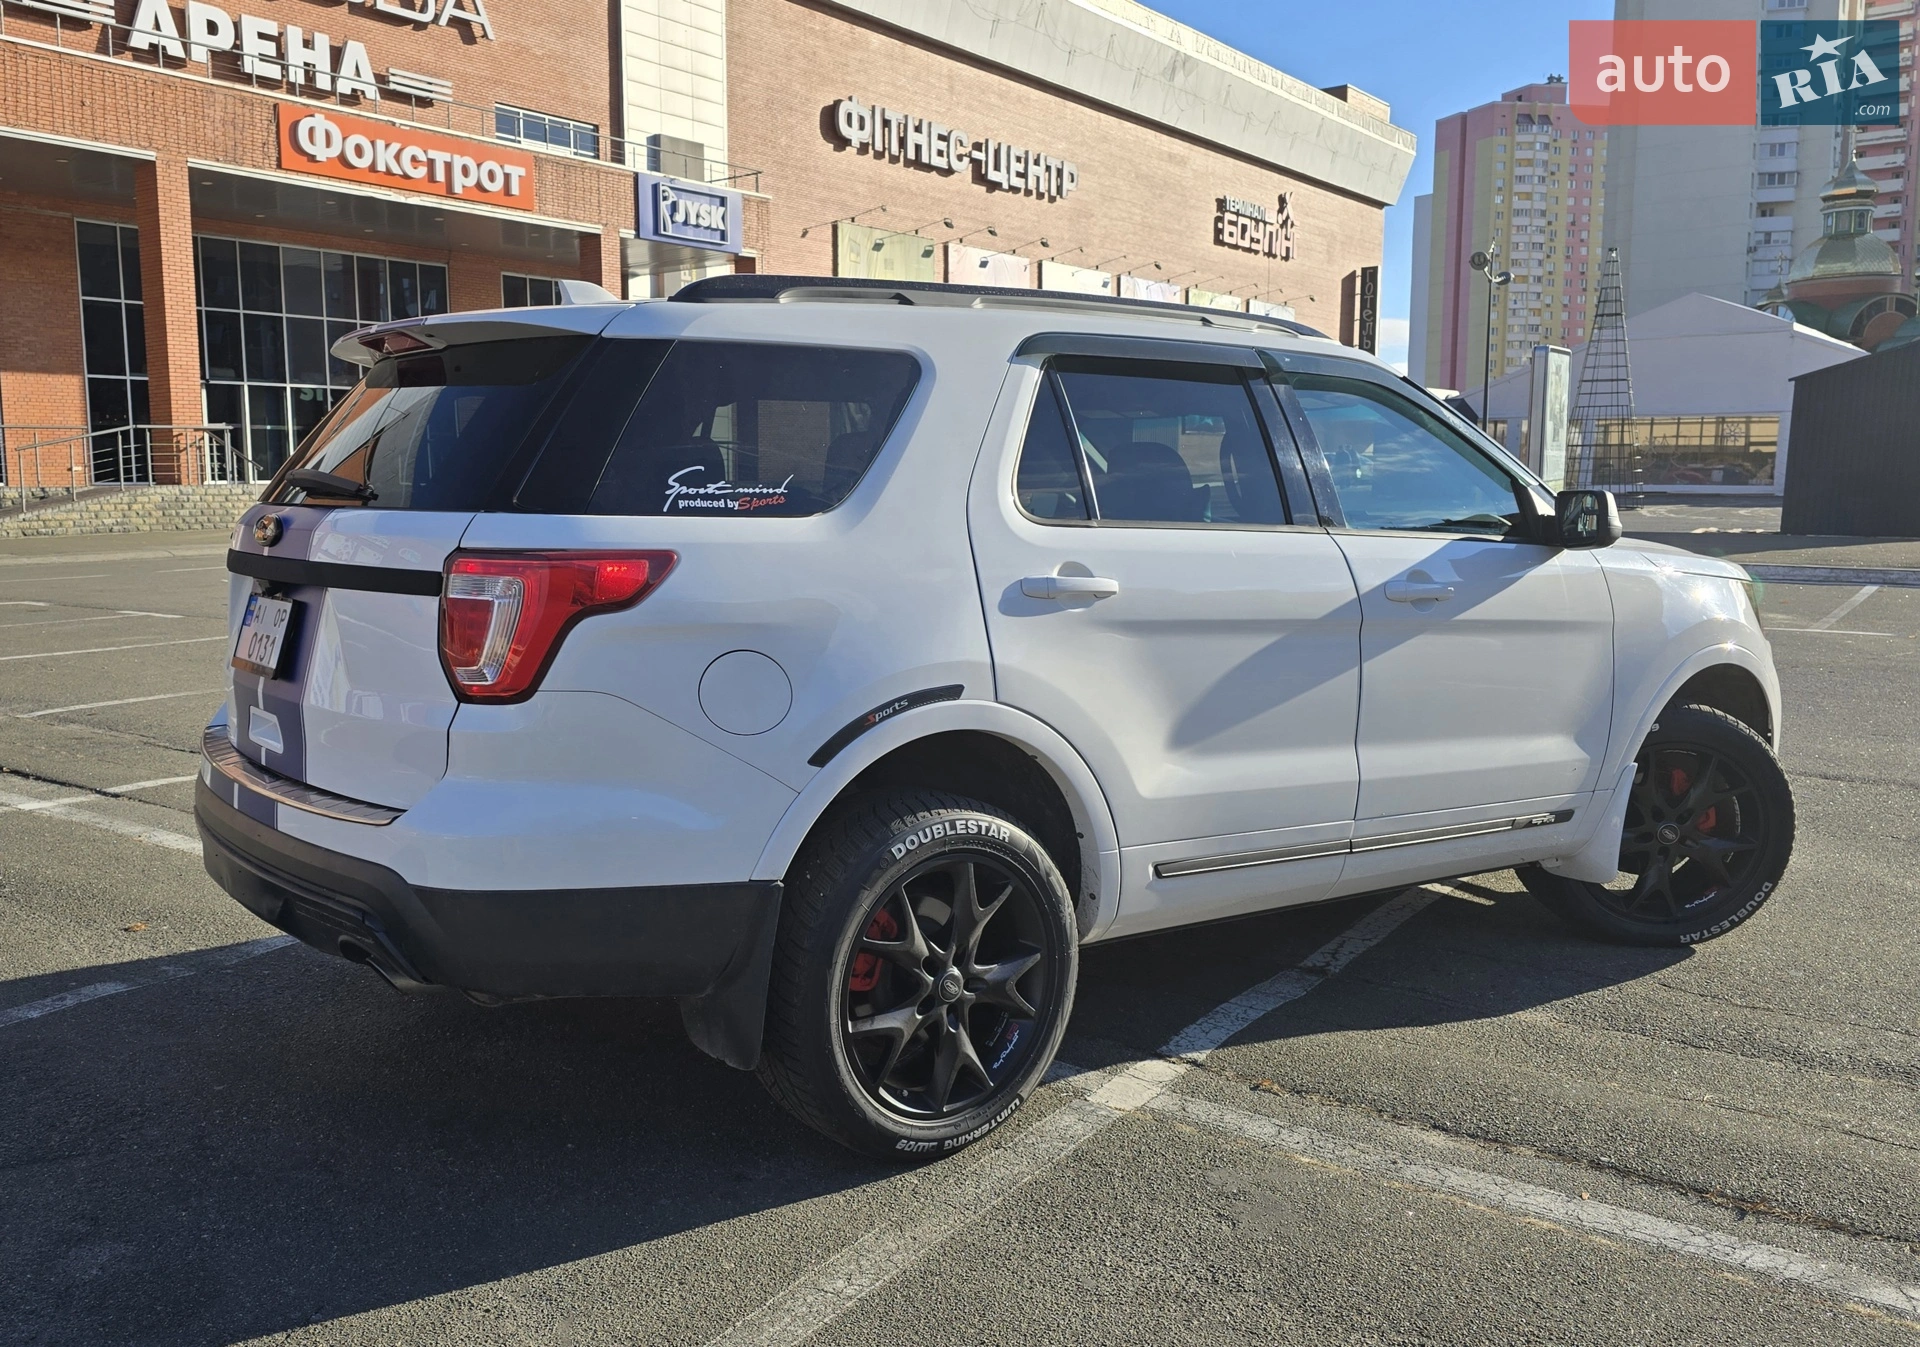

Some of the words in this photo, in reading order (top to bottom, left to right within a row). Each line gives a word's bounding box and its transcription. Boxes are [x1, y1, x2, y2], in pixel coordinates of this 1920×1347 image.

[127, 0, 380, 100] АРЕНА
[297, 113, 527, 196] Фокстрот
[836, 95, 1079, 199] ФІТНЕС-ЦЕНТР
[671, 198, 726, 231] JYSK
[678, 497, 725, 509] produced
[727, 498, 739, 511] by
[738, 494, 787, 511] Sports
[735, 474, 794, 494] mind
[248, 631, 277, 665] 0131
[864, 698, 909, 726] Sports
[891, 819, 1011, 861] DOUBLESTAR
[1680, 881, 1773, 944] DOUBLESTAR
